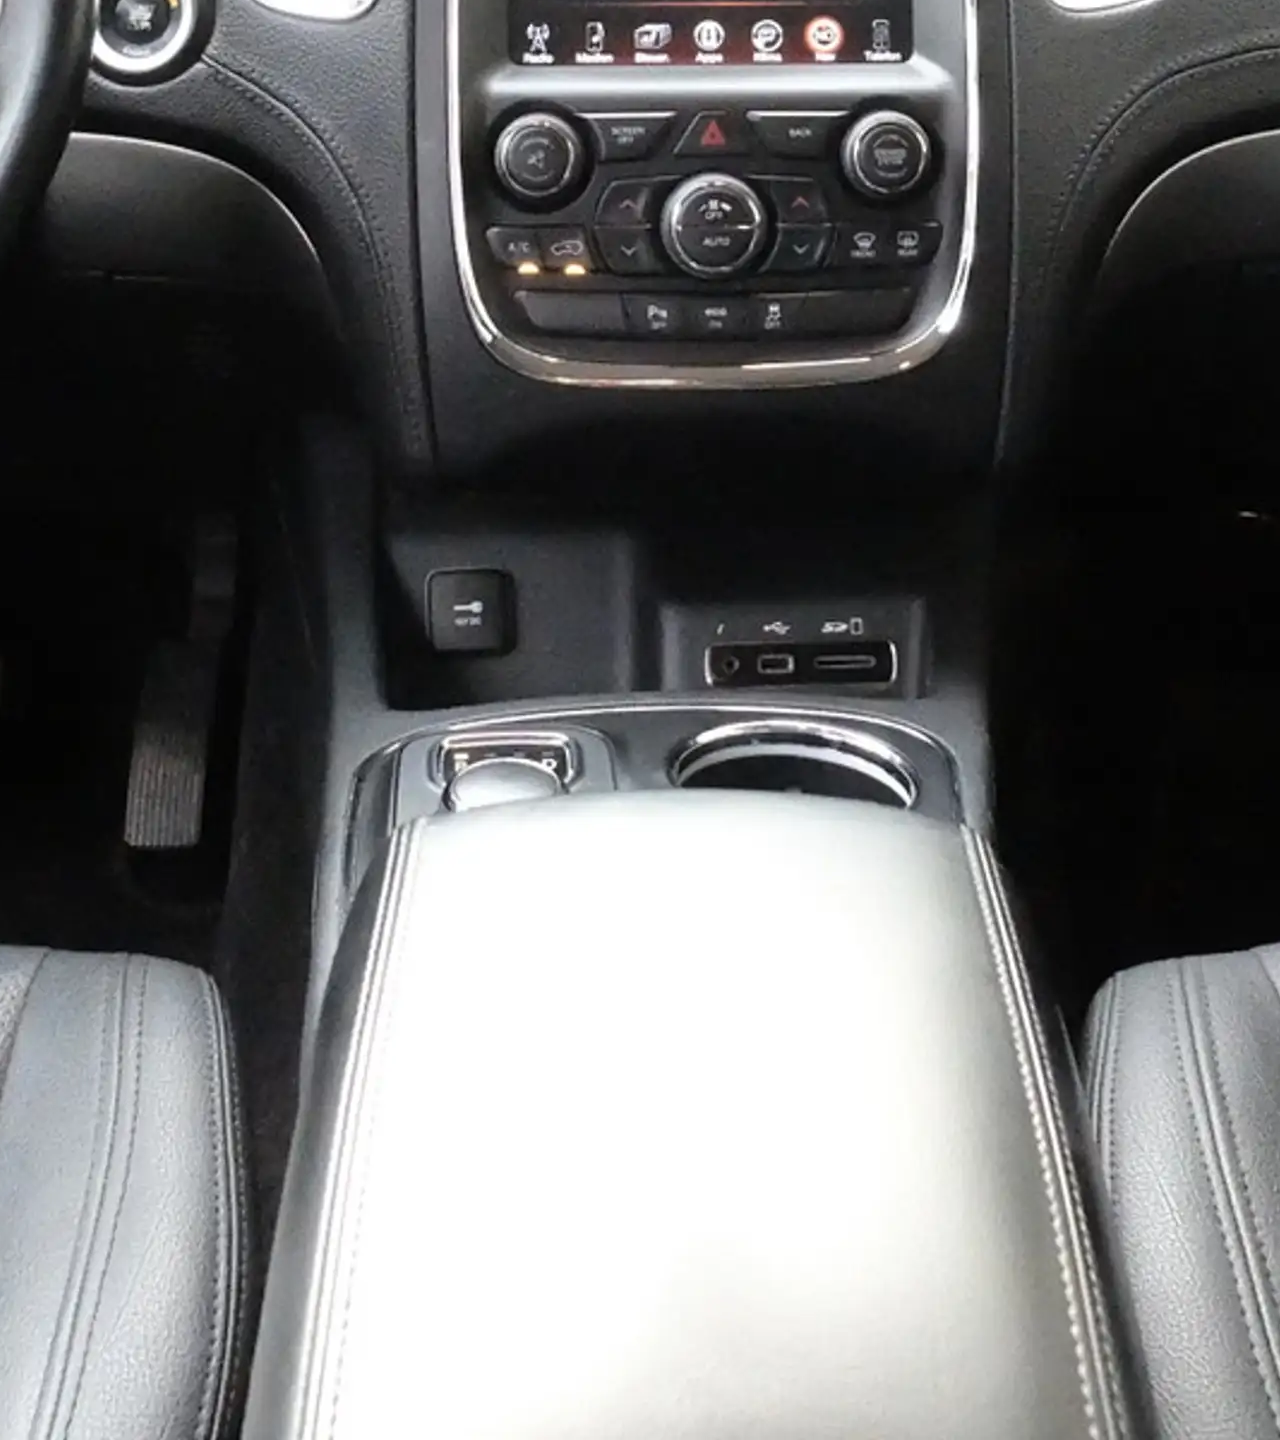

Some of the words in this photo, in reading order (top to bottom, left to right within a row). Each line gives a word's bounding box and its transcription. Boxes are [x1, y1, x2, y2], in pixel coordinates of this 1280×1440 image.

[610, 126, 646, 137] SCREEN
[788, 128, 813, 139] BACK
[702, 236, 731, 247] AUTO
